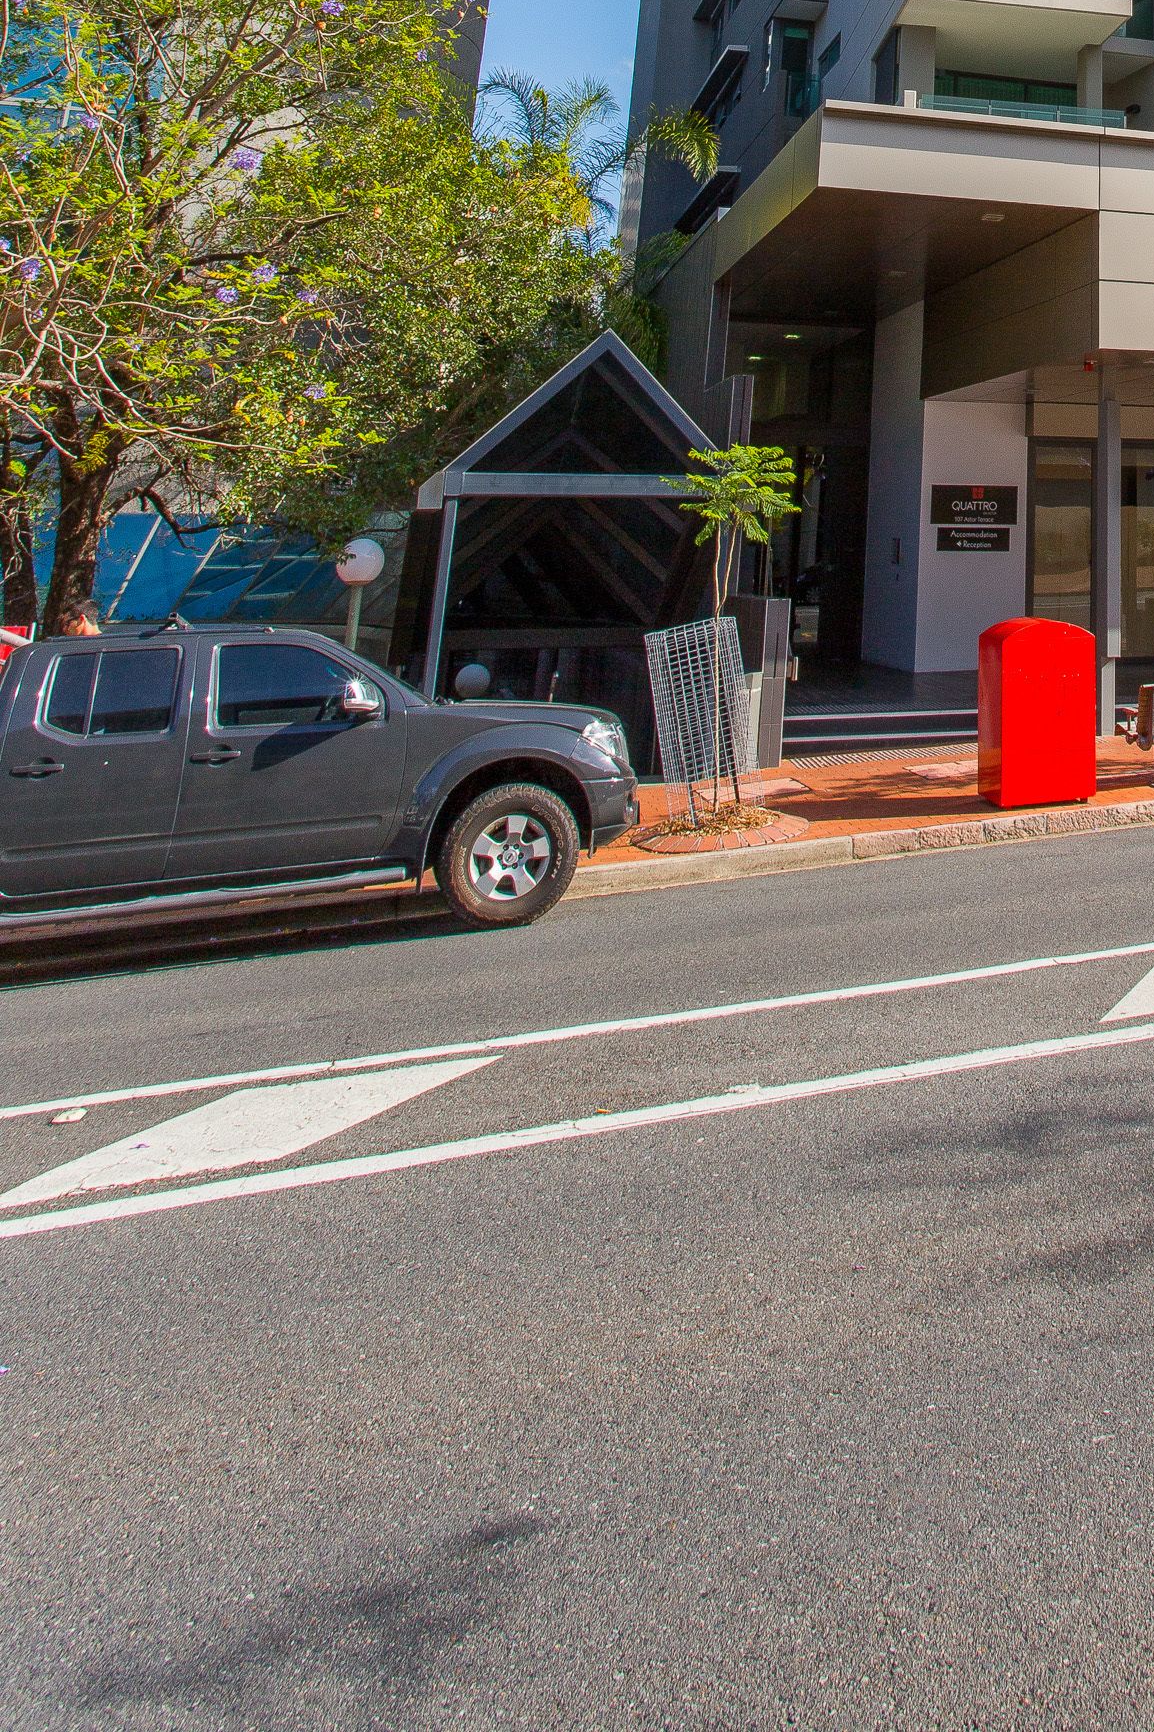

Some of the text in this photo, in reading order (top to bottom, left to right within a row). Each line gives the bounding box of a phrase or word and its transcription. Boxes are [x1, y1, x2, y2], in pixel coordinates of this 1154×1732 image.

[951, 500, 998, 511] QUATTRO
[950, 530, 998, 538] Accommodation
[962, 540, 992, 548] Reception
